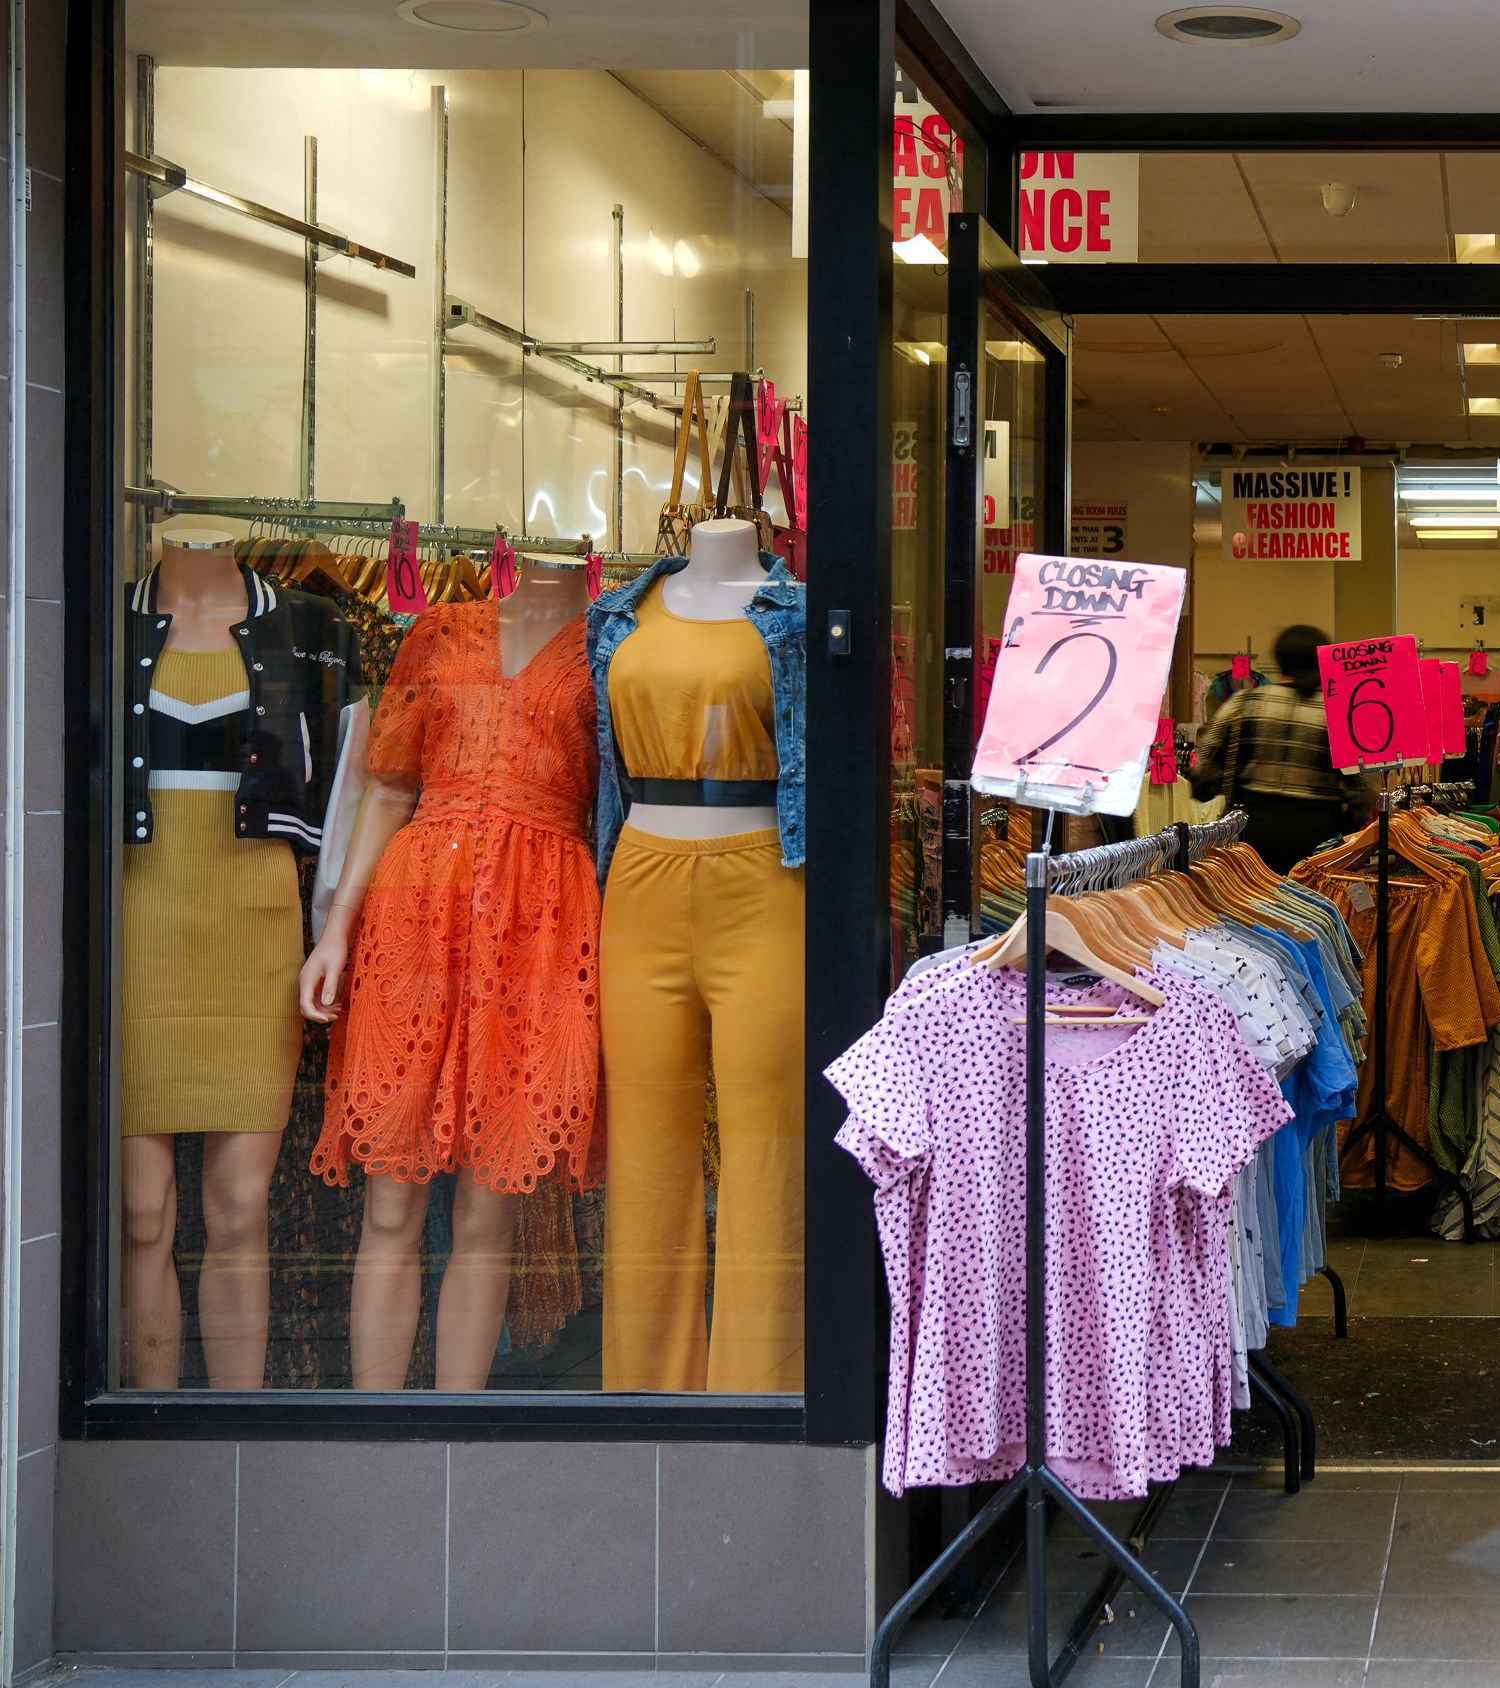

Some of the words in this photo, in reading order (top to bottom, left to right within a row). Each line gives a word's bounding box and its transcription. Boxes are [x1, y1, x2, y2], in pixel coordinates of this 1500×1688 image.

[1232, 472, 1337, 498] MASSIVE
[1247, 502, 1336, 530] FASHION
[1231, 531, 1351, 560] CLEARANCE
[1039, 560, 1155, 599] CLOSING
[1042, 586, 1128, 612] DOWN
[1332, 640, 1394, 661] CLOSING
[1344, 656, 1388, 671] DOWN
